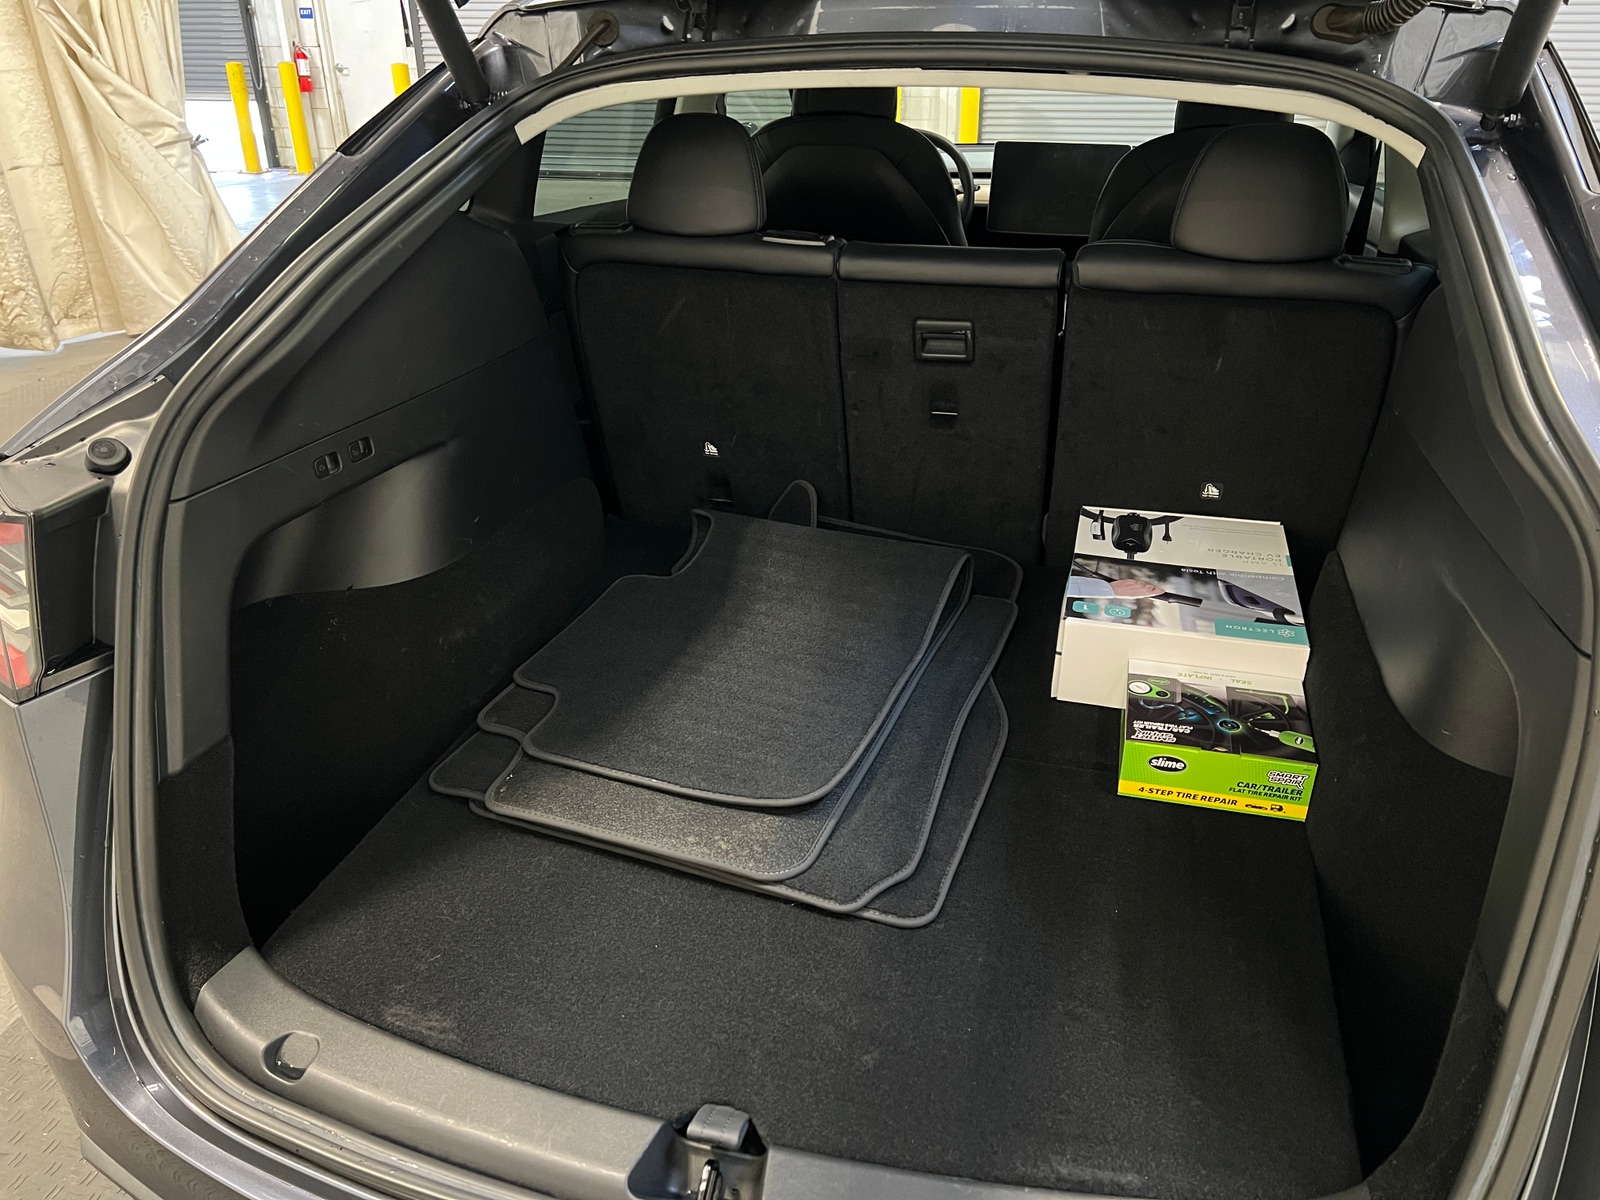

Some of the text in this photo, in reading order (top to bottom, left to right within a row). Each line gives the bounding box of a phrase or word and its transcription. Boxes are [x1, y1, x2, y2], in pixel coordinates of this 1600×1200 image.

[1229, 573, 1285, 581] Compatible
[1225, 624, 1275, 634] LECTRON
[1178, 672, 1213, 681] INFLATE
[1133, 724, 1190, 734] CAR/TRAILER
[1150, 758, 1185, 769] slime
[1267, 770, 1309, 780] SMART
[1269, 776, 1303, 789] SPAIR
[1237, 782, 1304, 796] CAR/TRAILER
[1138, 786, 1238, 806] 4-STEP TIRE REPAIR
[1264, 792, 1288, 800] REPAIR
